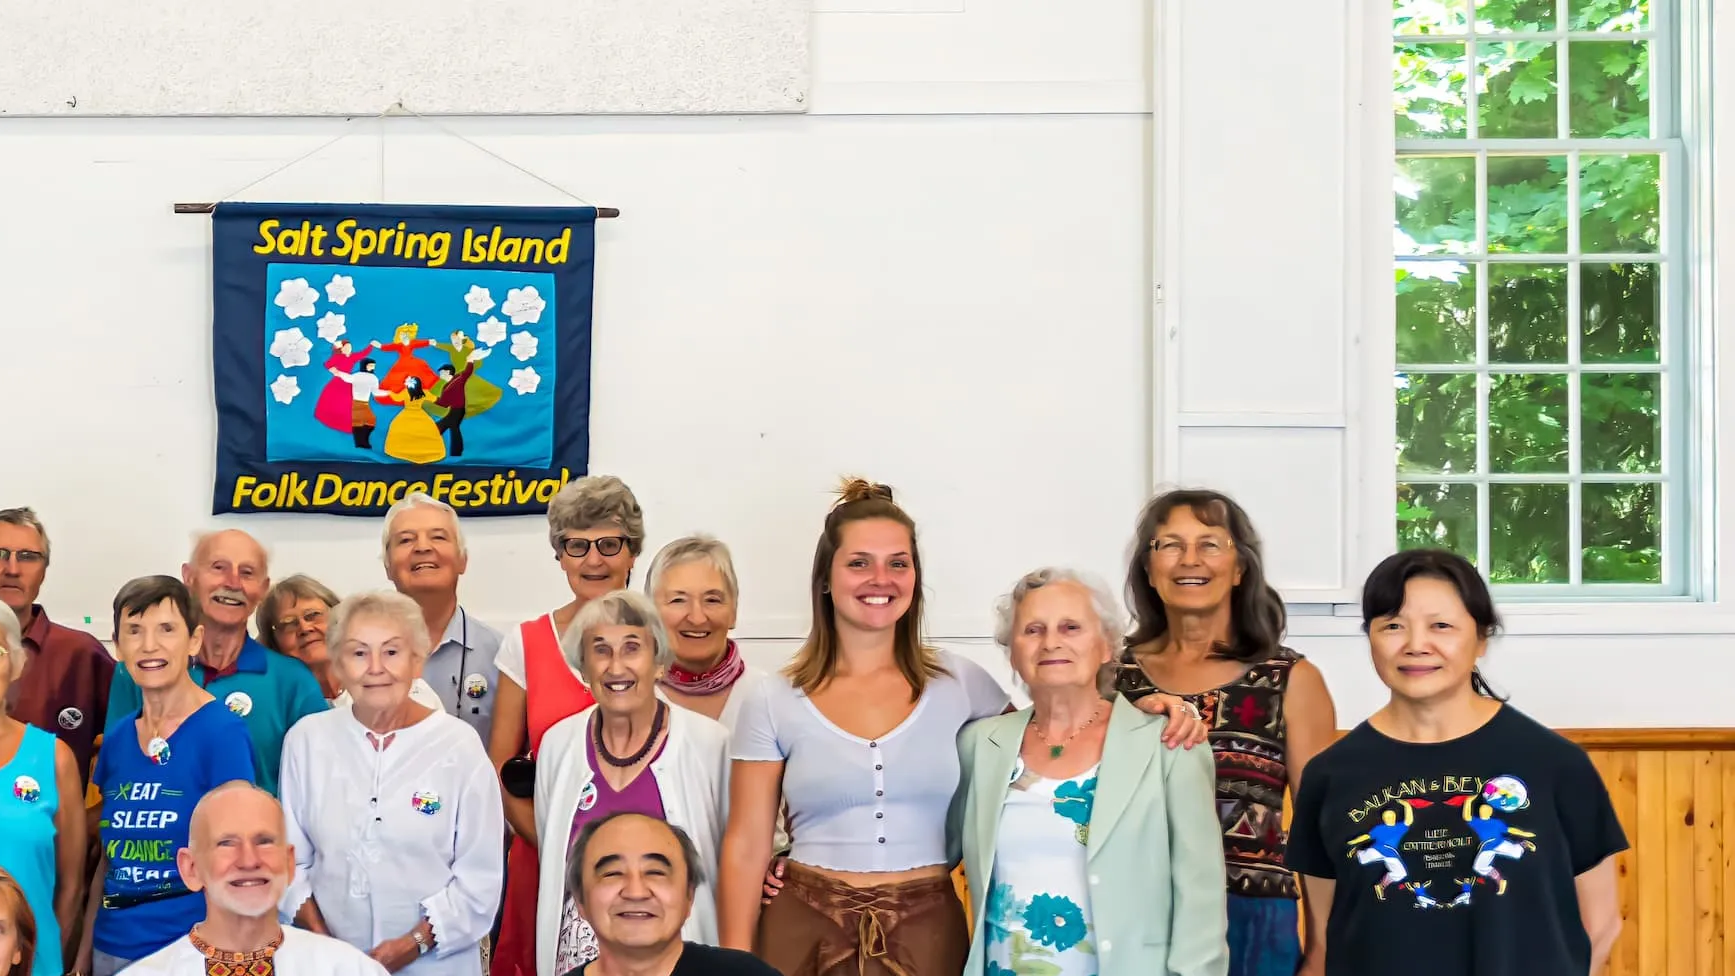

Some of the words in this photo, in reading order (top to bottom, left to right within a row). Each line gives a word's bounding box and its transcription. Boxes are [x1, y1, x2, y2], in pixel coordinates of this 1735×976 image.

[253, 219, 328, 257] Salt
[334, 219, 452, 268] Spring
[461, 226, 572, 265] Island
[231, 472, 310, 508] Folk
[429, 467, 570, 508] Festival
[130, 782, 162, 801] EAT
[1348, 778, 1426, 823] BALKAN
[1430, 781, 1440, 791] &
[1443, 776, 1486, 793] BEY
[111, 810, 178, 829] SLEEP
[120, 840, 175, 862] DANCE
